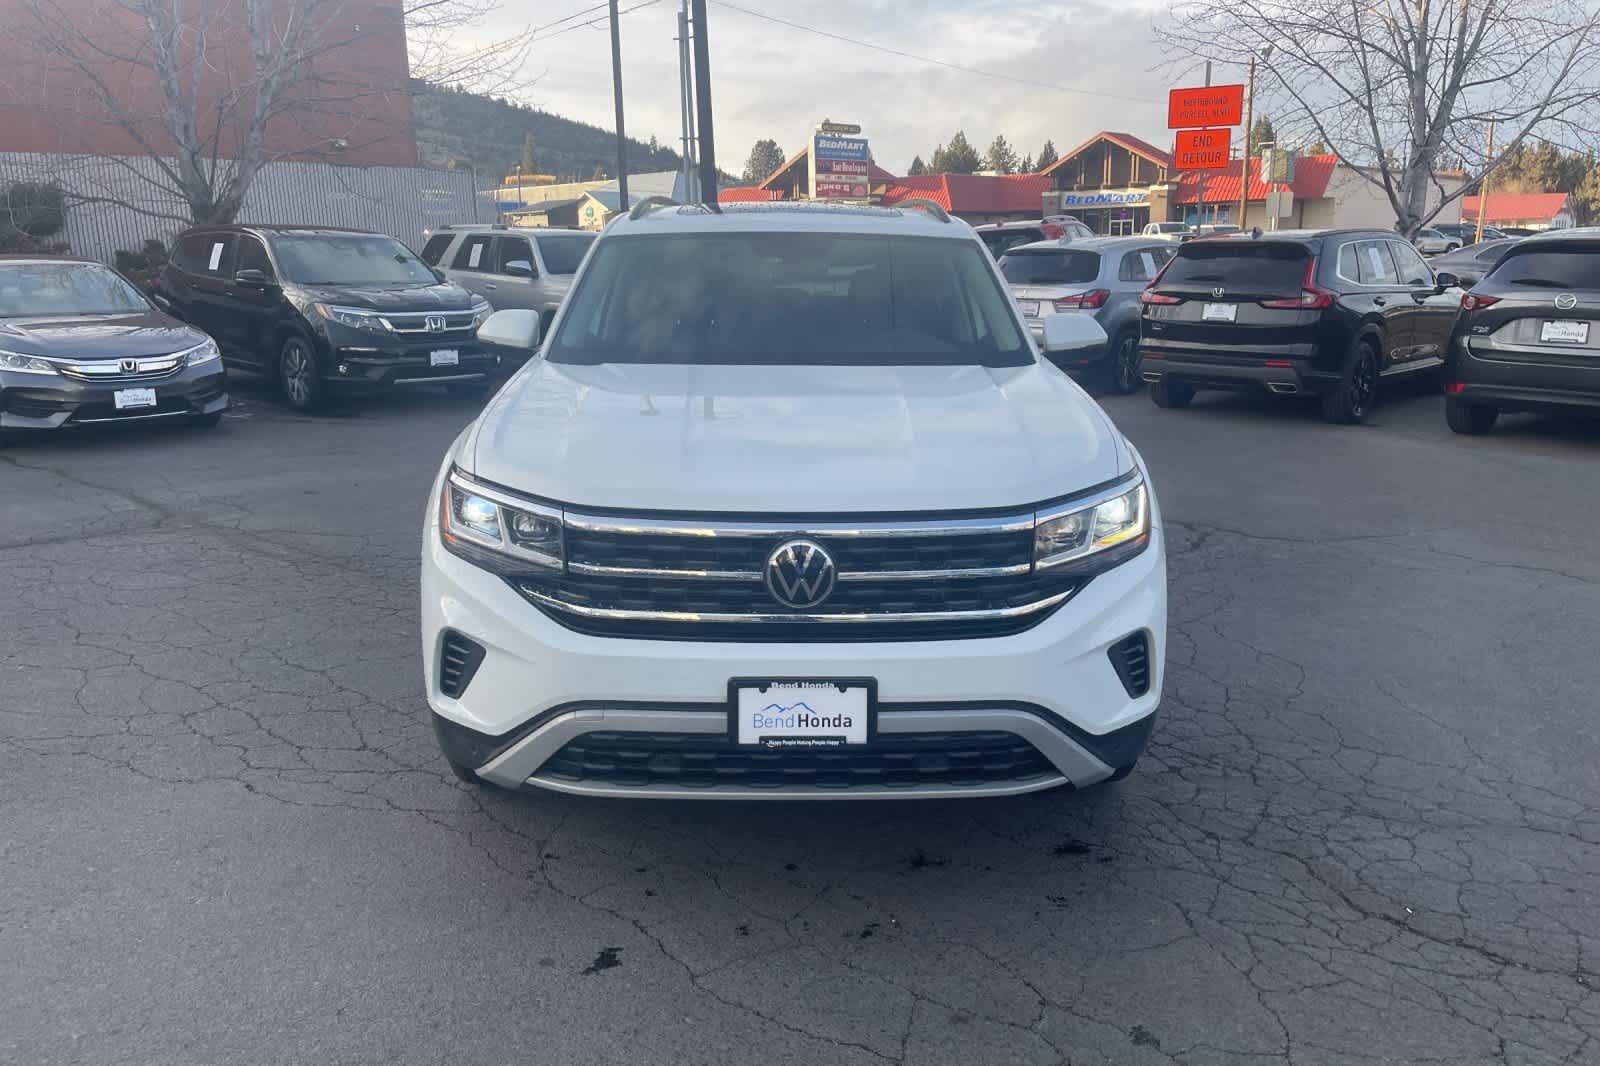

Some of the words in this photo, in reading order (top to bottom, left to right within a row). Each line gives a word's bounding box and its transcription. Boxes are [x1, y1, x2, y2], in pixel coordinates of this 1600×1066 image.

[1193, 136, 1213, 147] END
[1182, 152, 1221, 164] DETOUR
[752, 713, 795, 729] Bend
[797, 713, 853, 728] Honda
